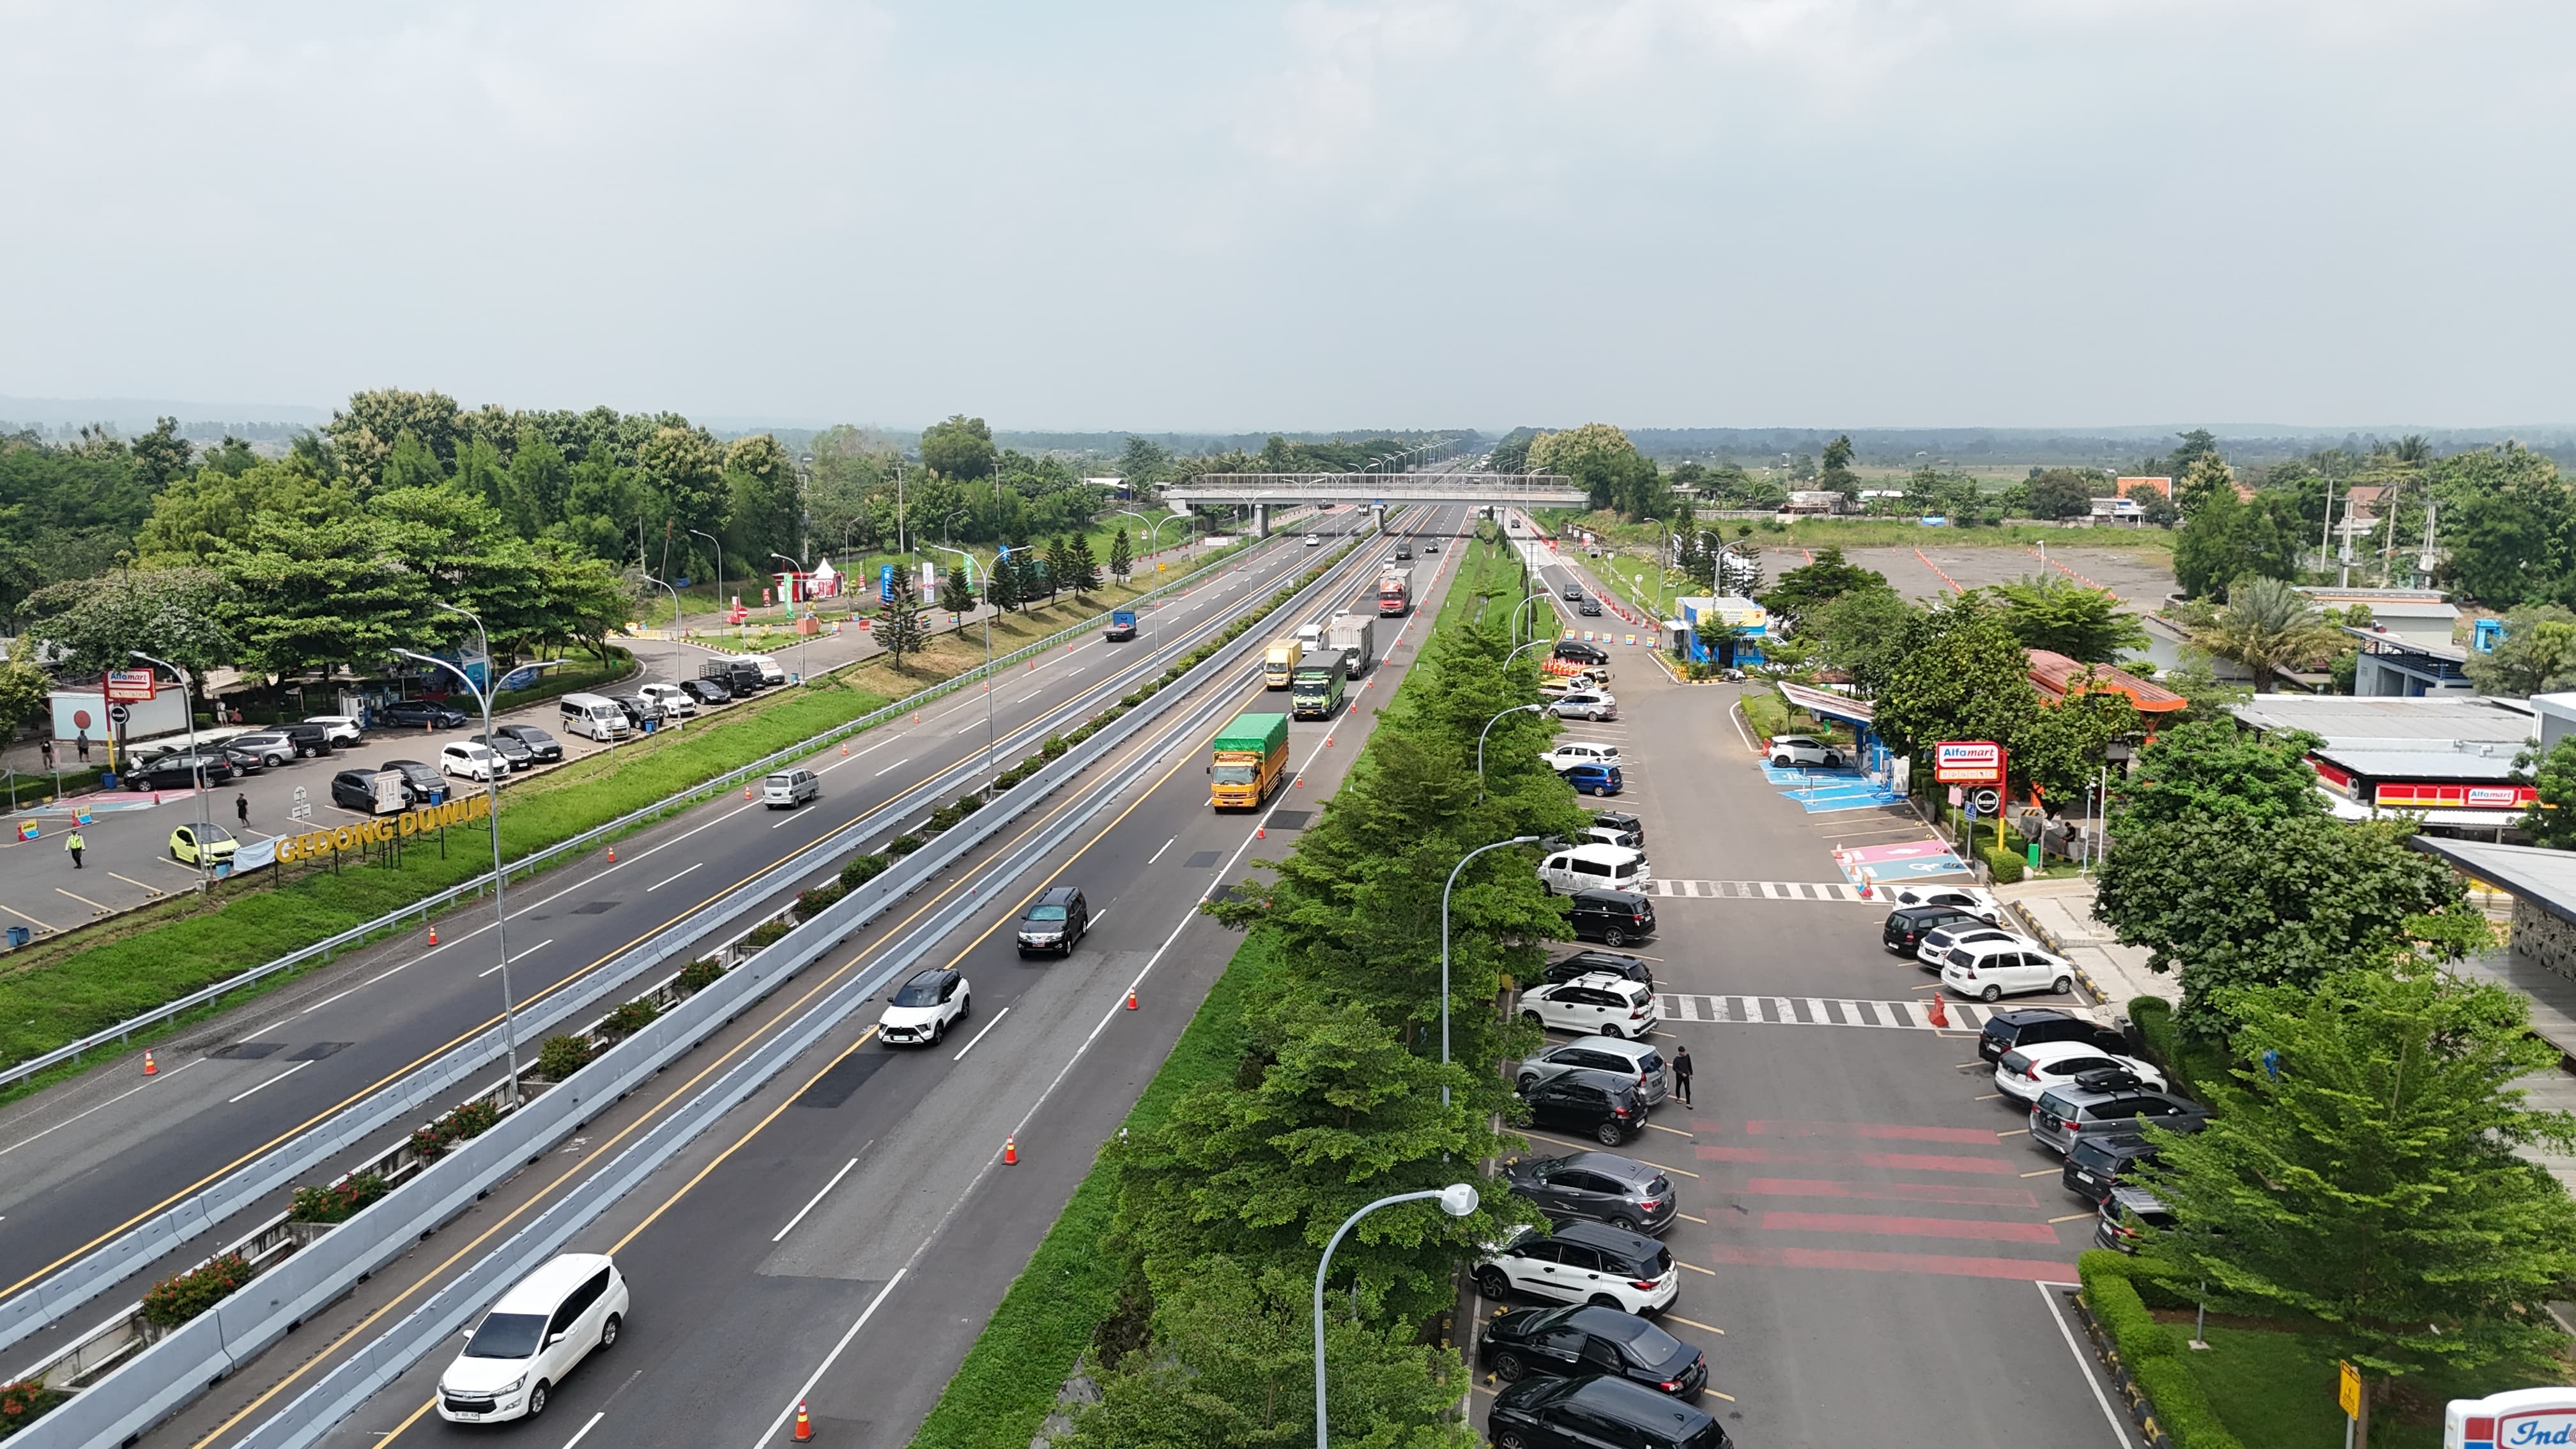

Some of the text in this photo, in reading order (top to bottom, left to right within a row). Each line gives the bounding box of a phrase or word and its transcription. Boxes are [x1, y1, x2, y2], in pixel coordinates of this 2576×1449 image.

[1943, 748, 1994, 756] Alfamart
[275, 795, 493, 863] GEDONG DUWUR
